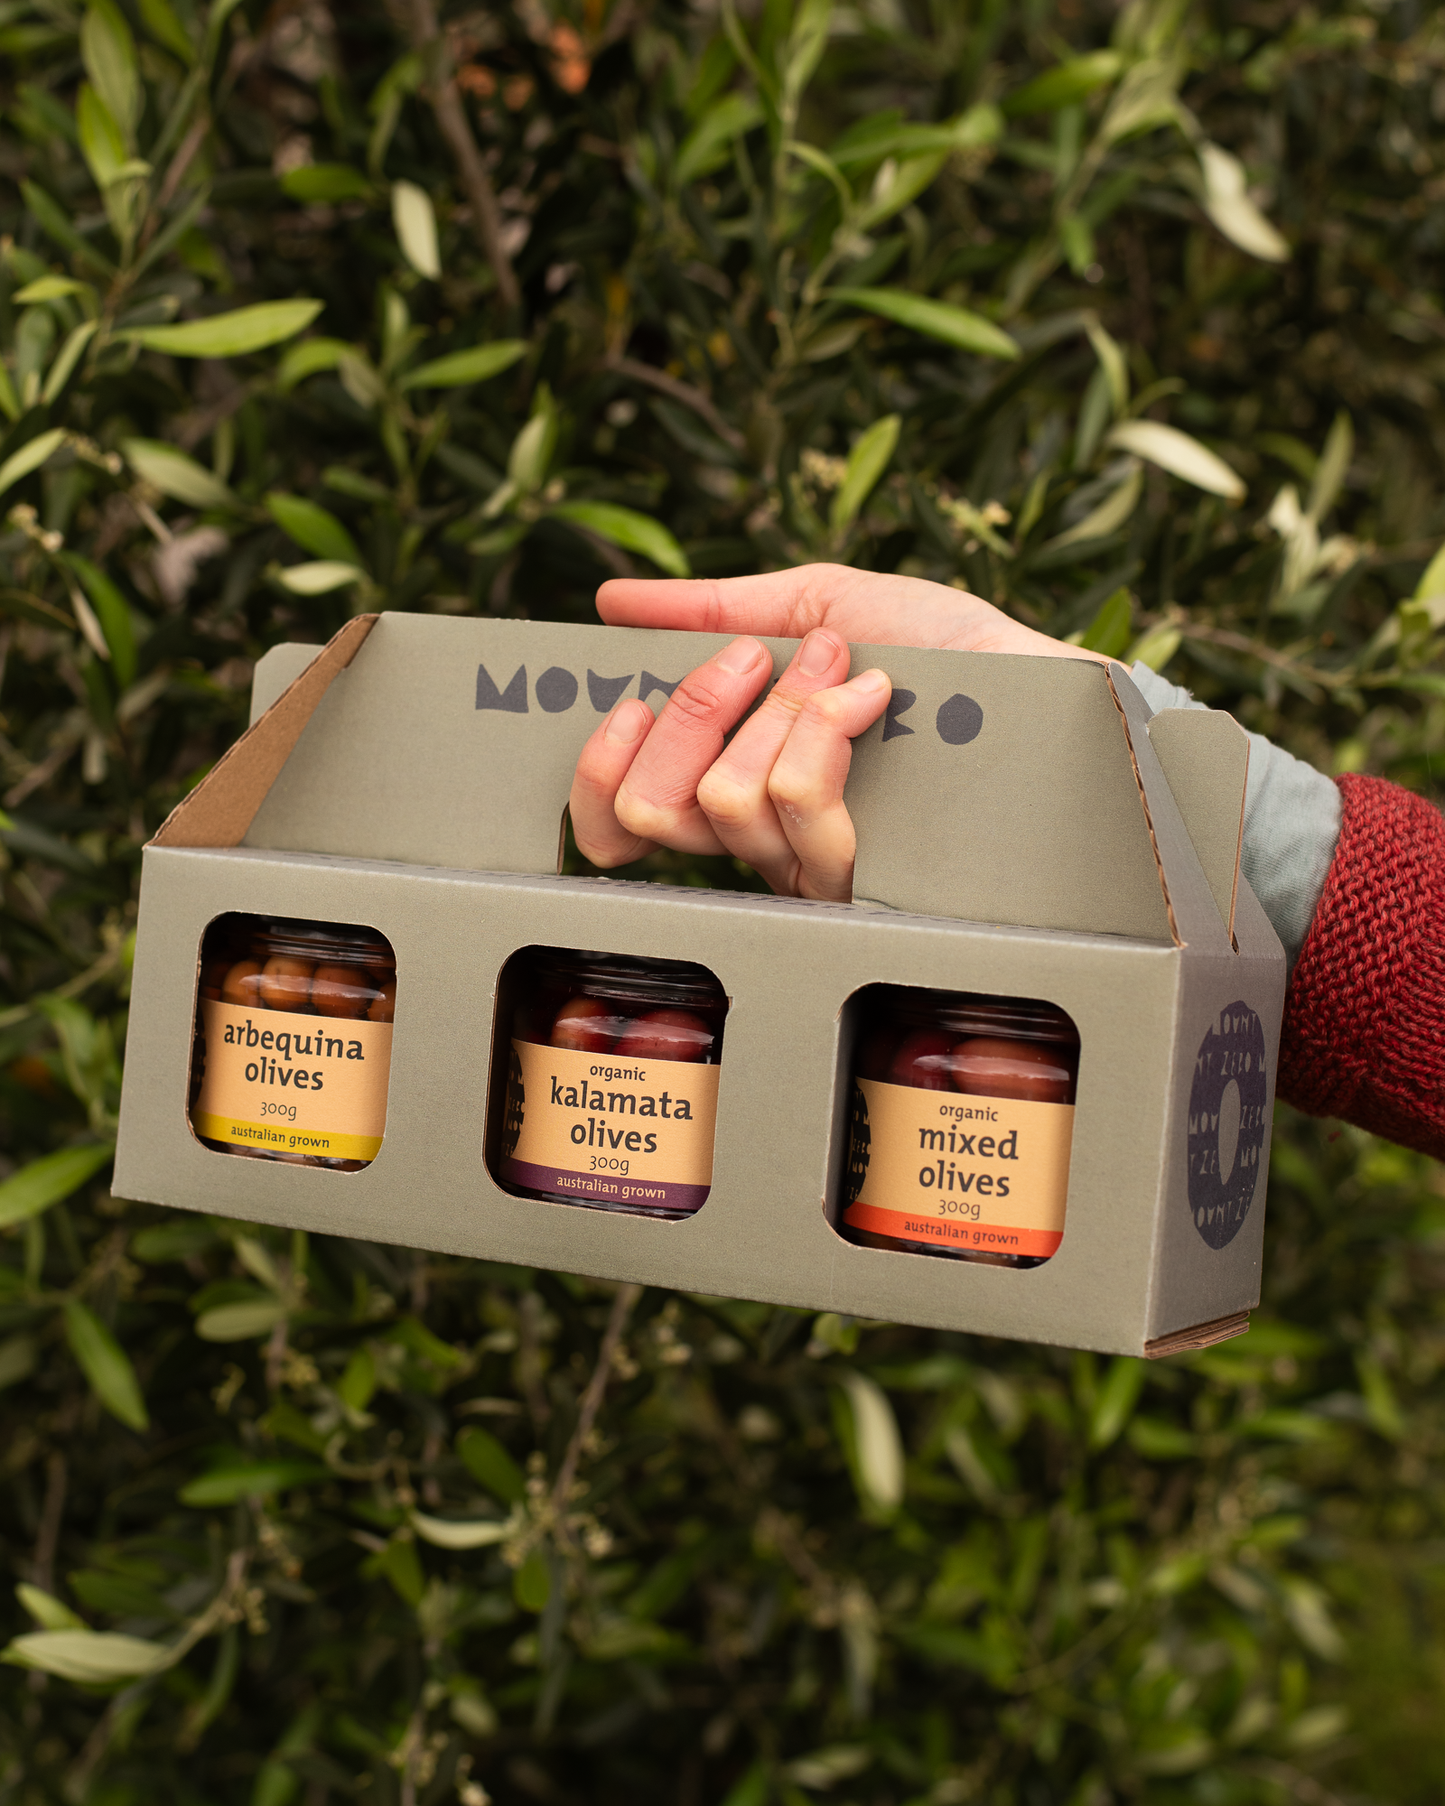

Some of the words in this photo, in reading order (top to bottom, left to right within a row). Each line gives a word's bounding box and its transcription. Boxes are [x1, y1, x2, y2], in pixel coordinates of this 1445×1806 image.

[881, 688, 984, 746] RO
[224, 1019, 365, 1061] arbequina
[245, 1056, 324, 1091] olives
[589, 1063, 647, 1083] organic
[1220, 1051, 1251, 1076] ZERO
[550, 1076, 693, 1121] kalamata
[260, 1101, 297, 1122] 300g
[939, 1104, 999, 1123] organic
[231, 1125, 286, 1144] australian
[289, 1134, 330, 1149] grown
[570, 1117, 658, 1154] olives
[918, 1124, 1019, 1161] mixed
[589, 1155, 630, 1176] 300g
[557, 1175, 618, 1194] australian
[621, 1184, 666, 1199] grown
[918, 1159, 1011, 1198] olives
[938, 1199, 981, 1221] 300g
[904, 1220, 969, 1240] australian
[972, 1230, 1019, 1246] grown
